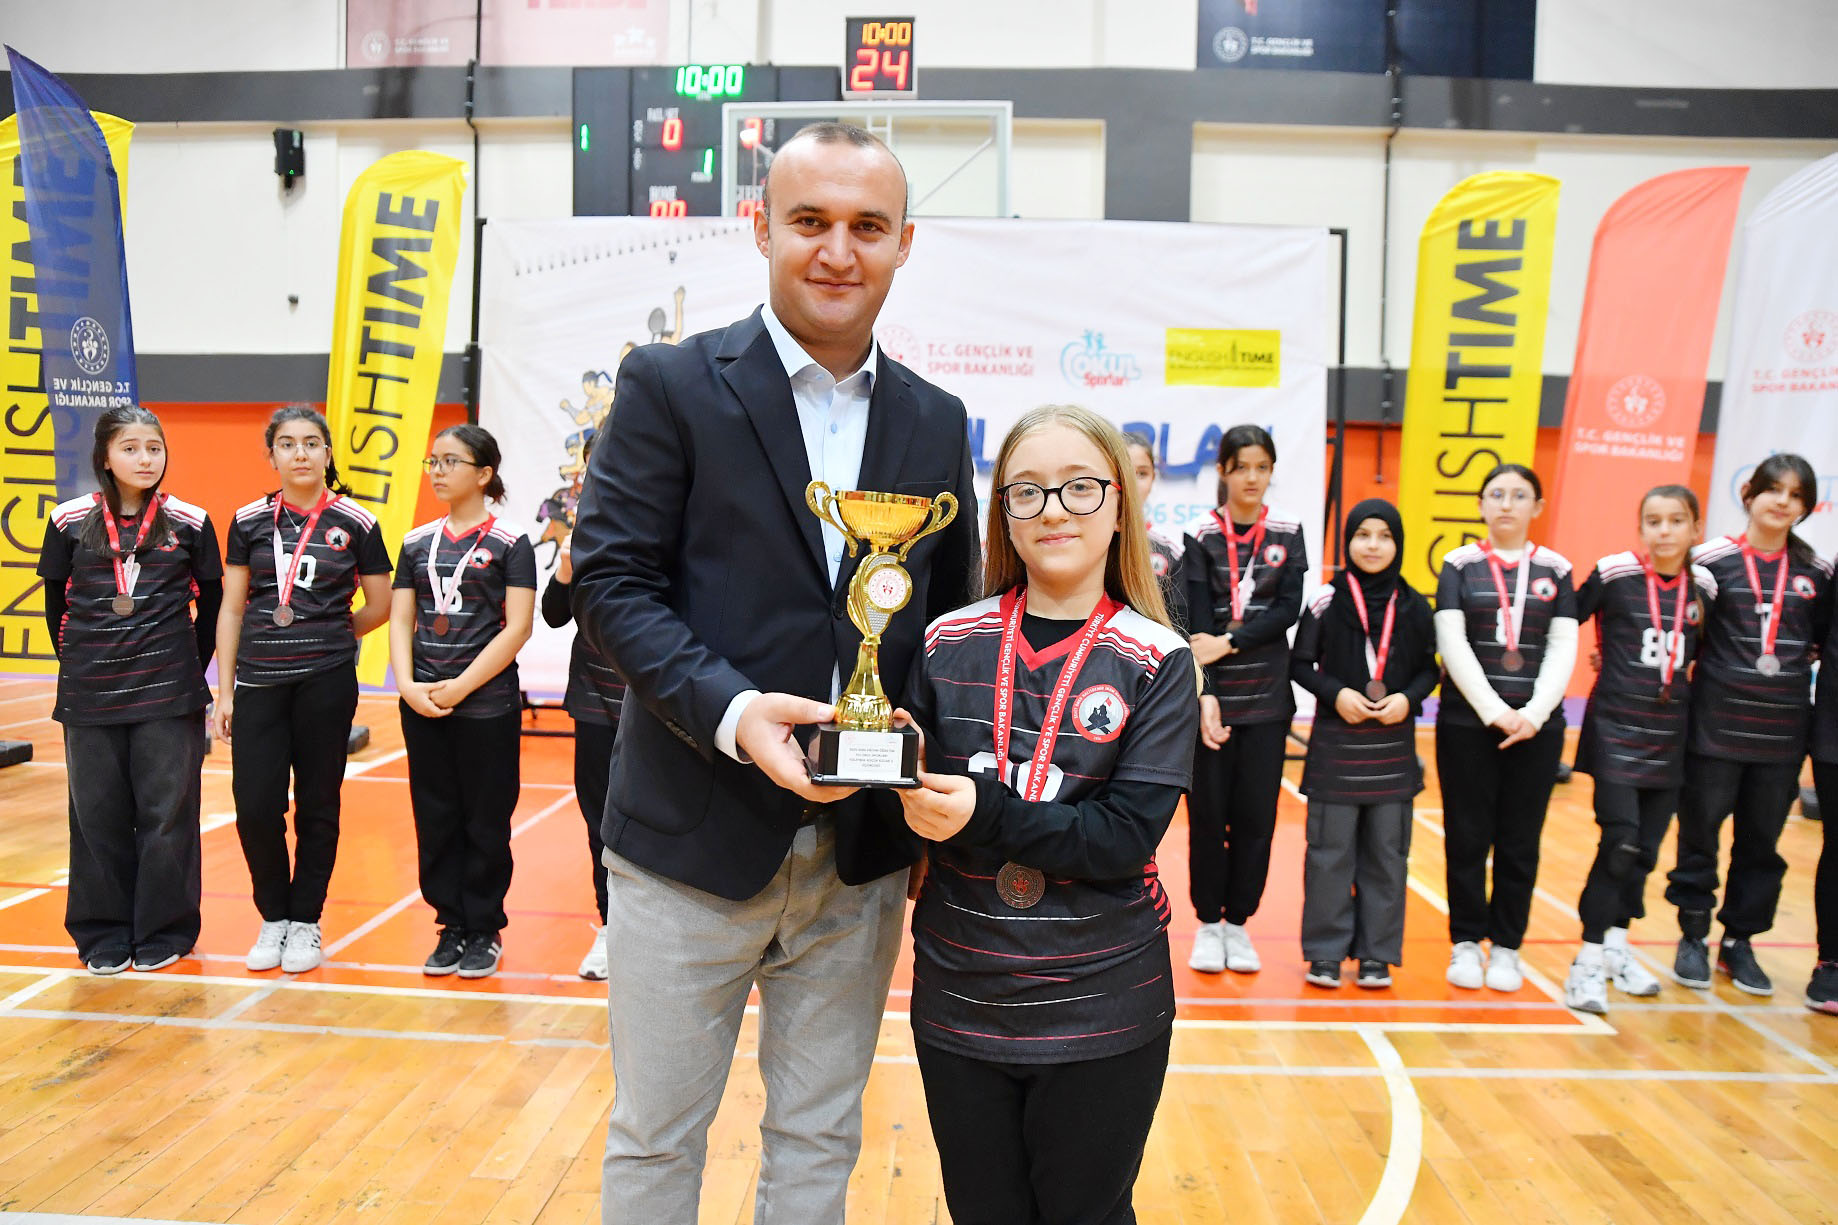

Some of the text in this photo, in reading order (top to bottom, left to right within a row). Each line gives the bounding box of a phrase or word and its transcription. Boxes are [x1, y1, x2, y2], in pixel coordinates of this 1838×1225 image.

[862, 22, 912, 46] 10:00
[675, 65, 744, 96] 10:00
[851, 48, 909, 91] 24
[662, 118, 683, 150] 0
[703, 148, 714, 176] 1
[1017, 345, 1034, 358] VE
[928, 362, 961, 375] SPOR
[1001, 643, 1013, 675] GENÇLİK
[1060, 638, 1090, 687] CUMHURİYETİ
[1000, 677, 1009, 687] VE
[999, 688, 1008, 710] SPOR
[1048, 687, 1066, 724] GENÇLİK
[997, 712, 1007, 760] BAKANLIĞI
[1044, 725, 1056, 737] VE
[1037, 738, 1051, 763] SPOR
[1028, 763, 1045, 802] BAKANL
